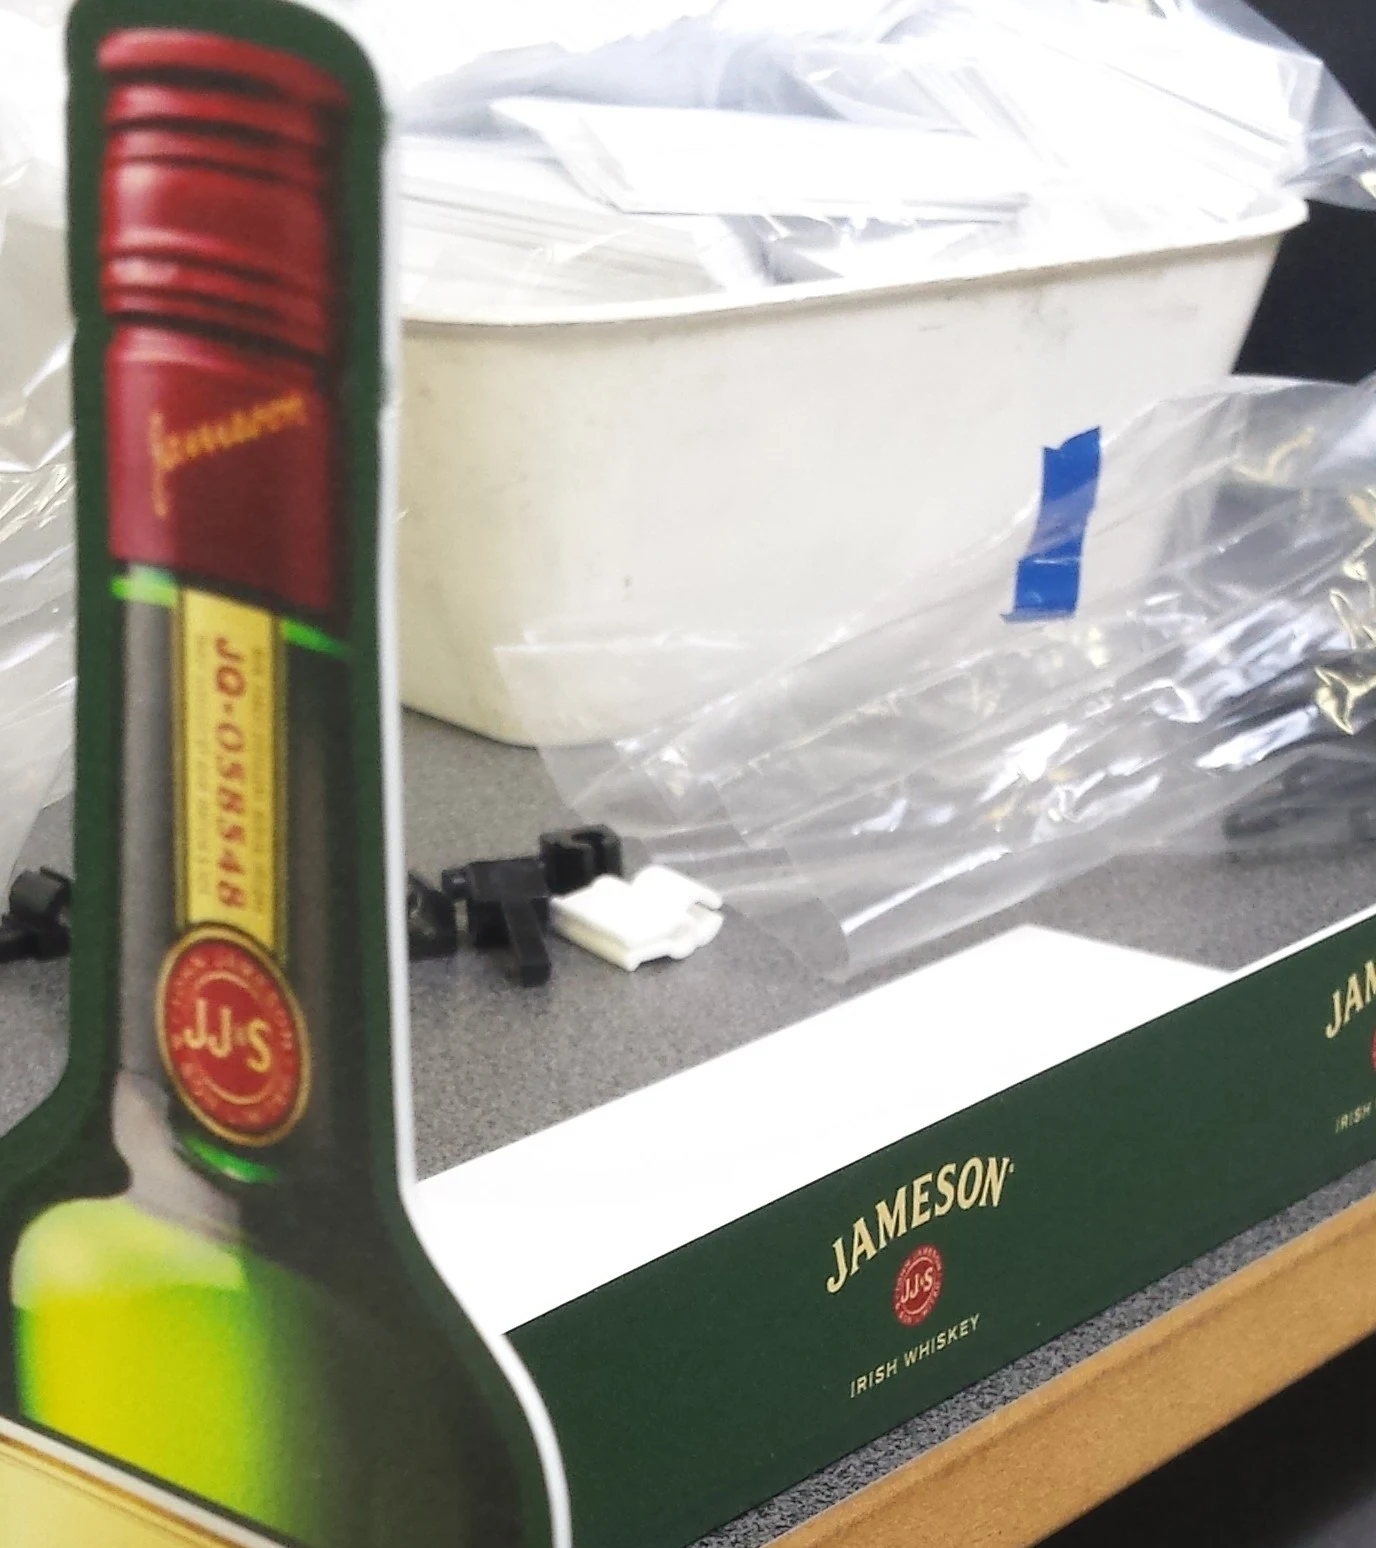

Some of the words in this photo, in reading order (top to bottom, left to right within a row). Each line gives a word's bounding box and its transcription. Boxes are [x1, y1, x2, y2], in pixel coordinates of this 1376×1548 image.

[1335, 1101, 1372, 1134] IRISH
[826, 1155, 1011, 1294] JAMESON
[850, 1357, 899, 1399] IRISH
[903, 1312, 981, 1369] WHISKEY
